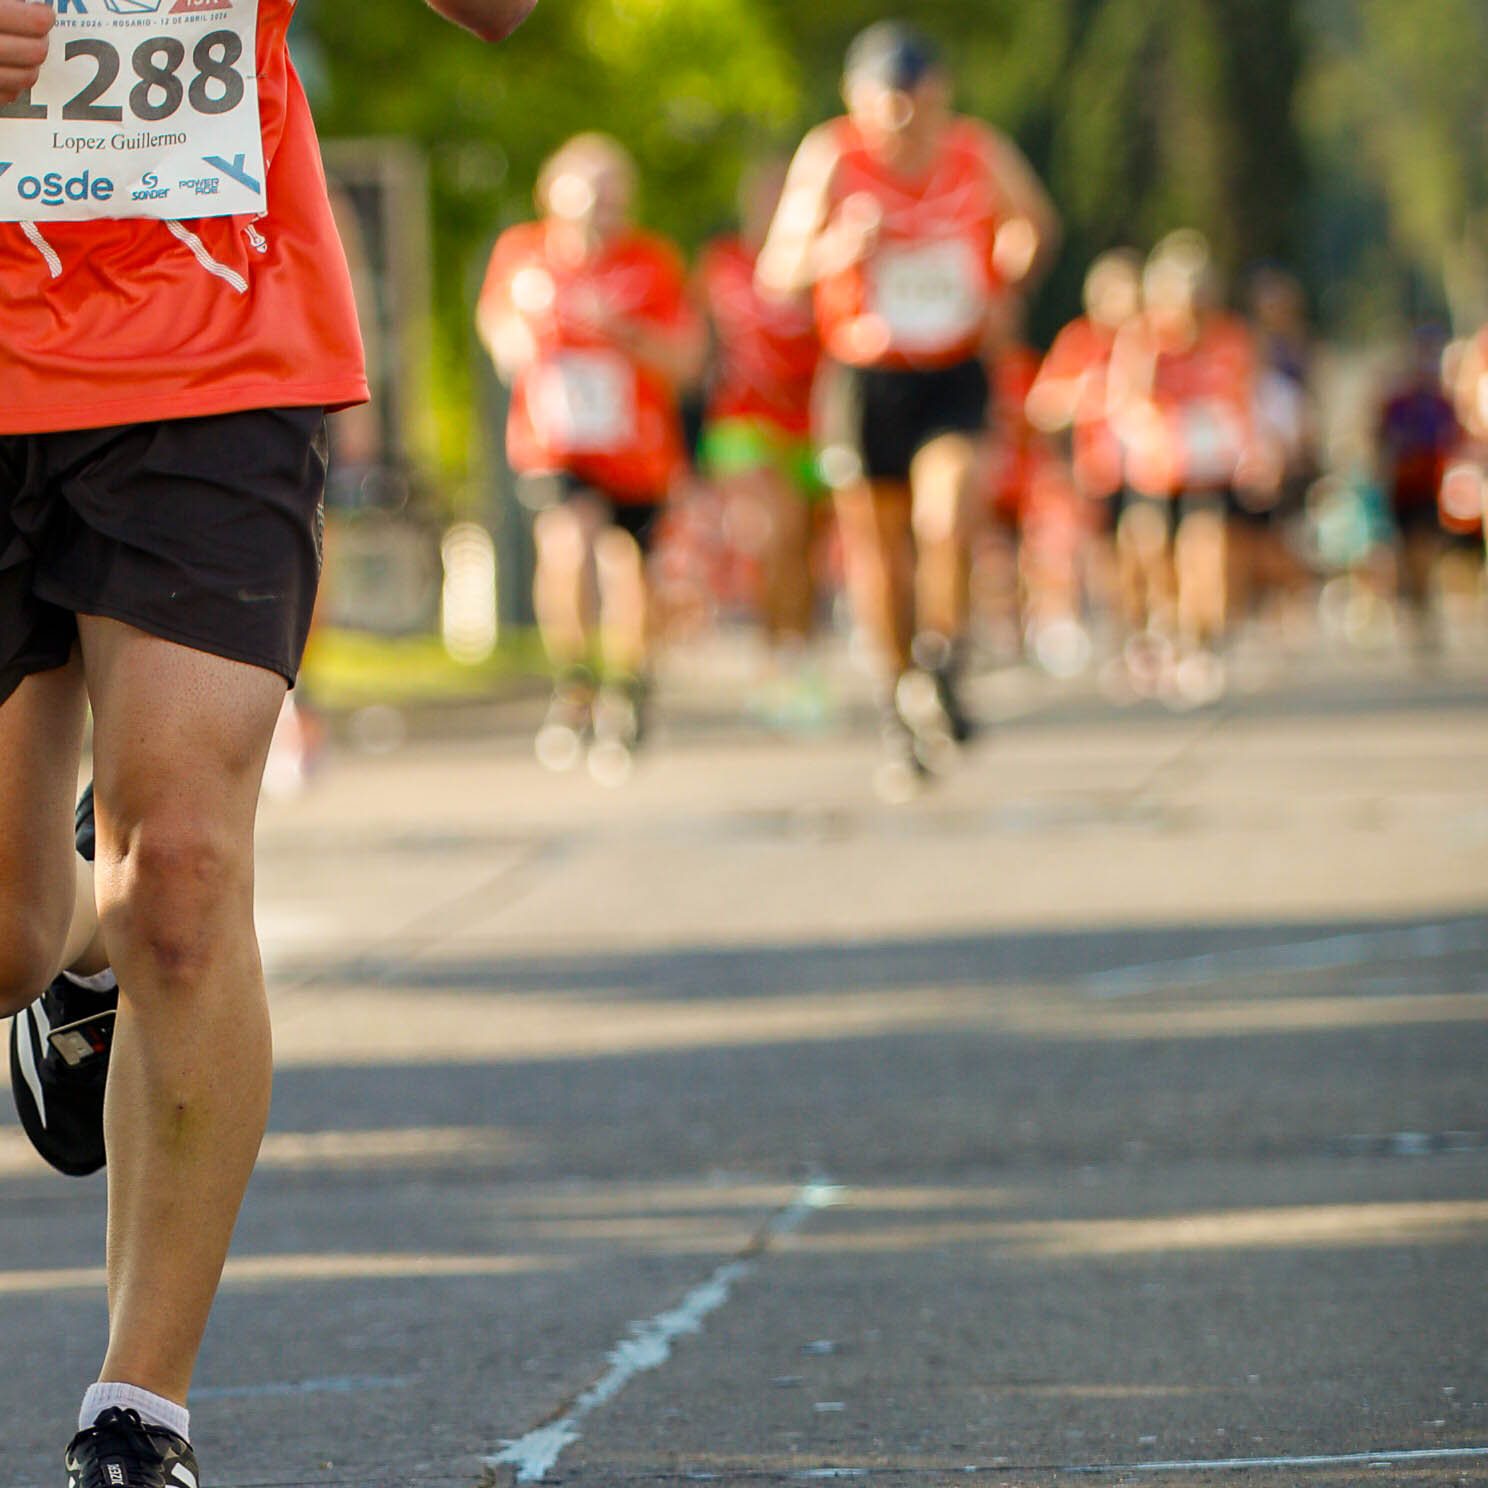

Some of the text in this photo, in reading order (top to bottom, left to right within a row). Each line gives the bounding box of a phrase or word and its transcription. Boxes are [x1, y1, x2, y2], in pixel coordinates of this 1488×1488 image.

[55, 19, 77, 28] ORTE
[112, 19, 151, 28] ROSARIO
[172, 16, 182, 25] DE
[184, 14, 207, 23] ABRIL
[52, 131, 187, 154] Lopez Guillermo
[17, 169, 114, 206] osde
